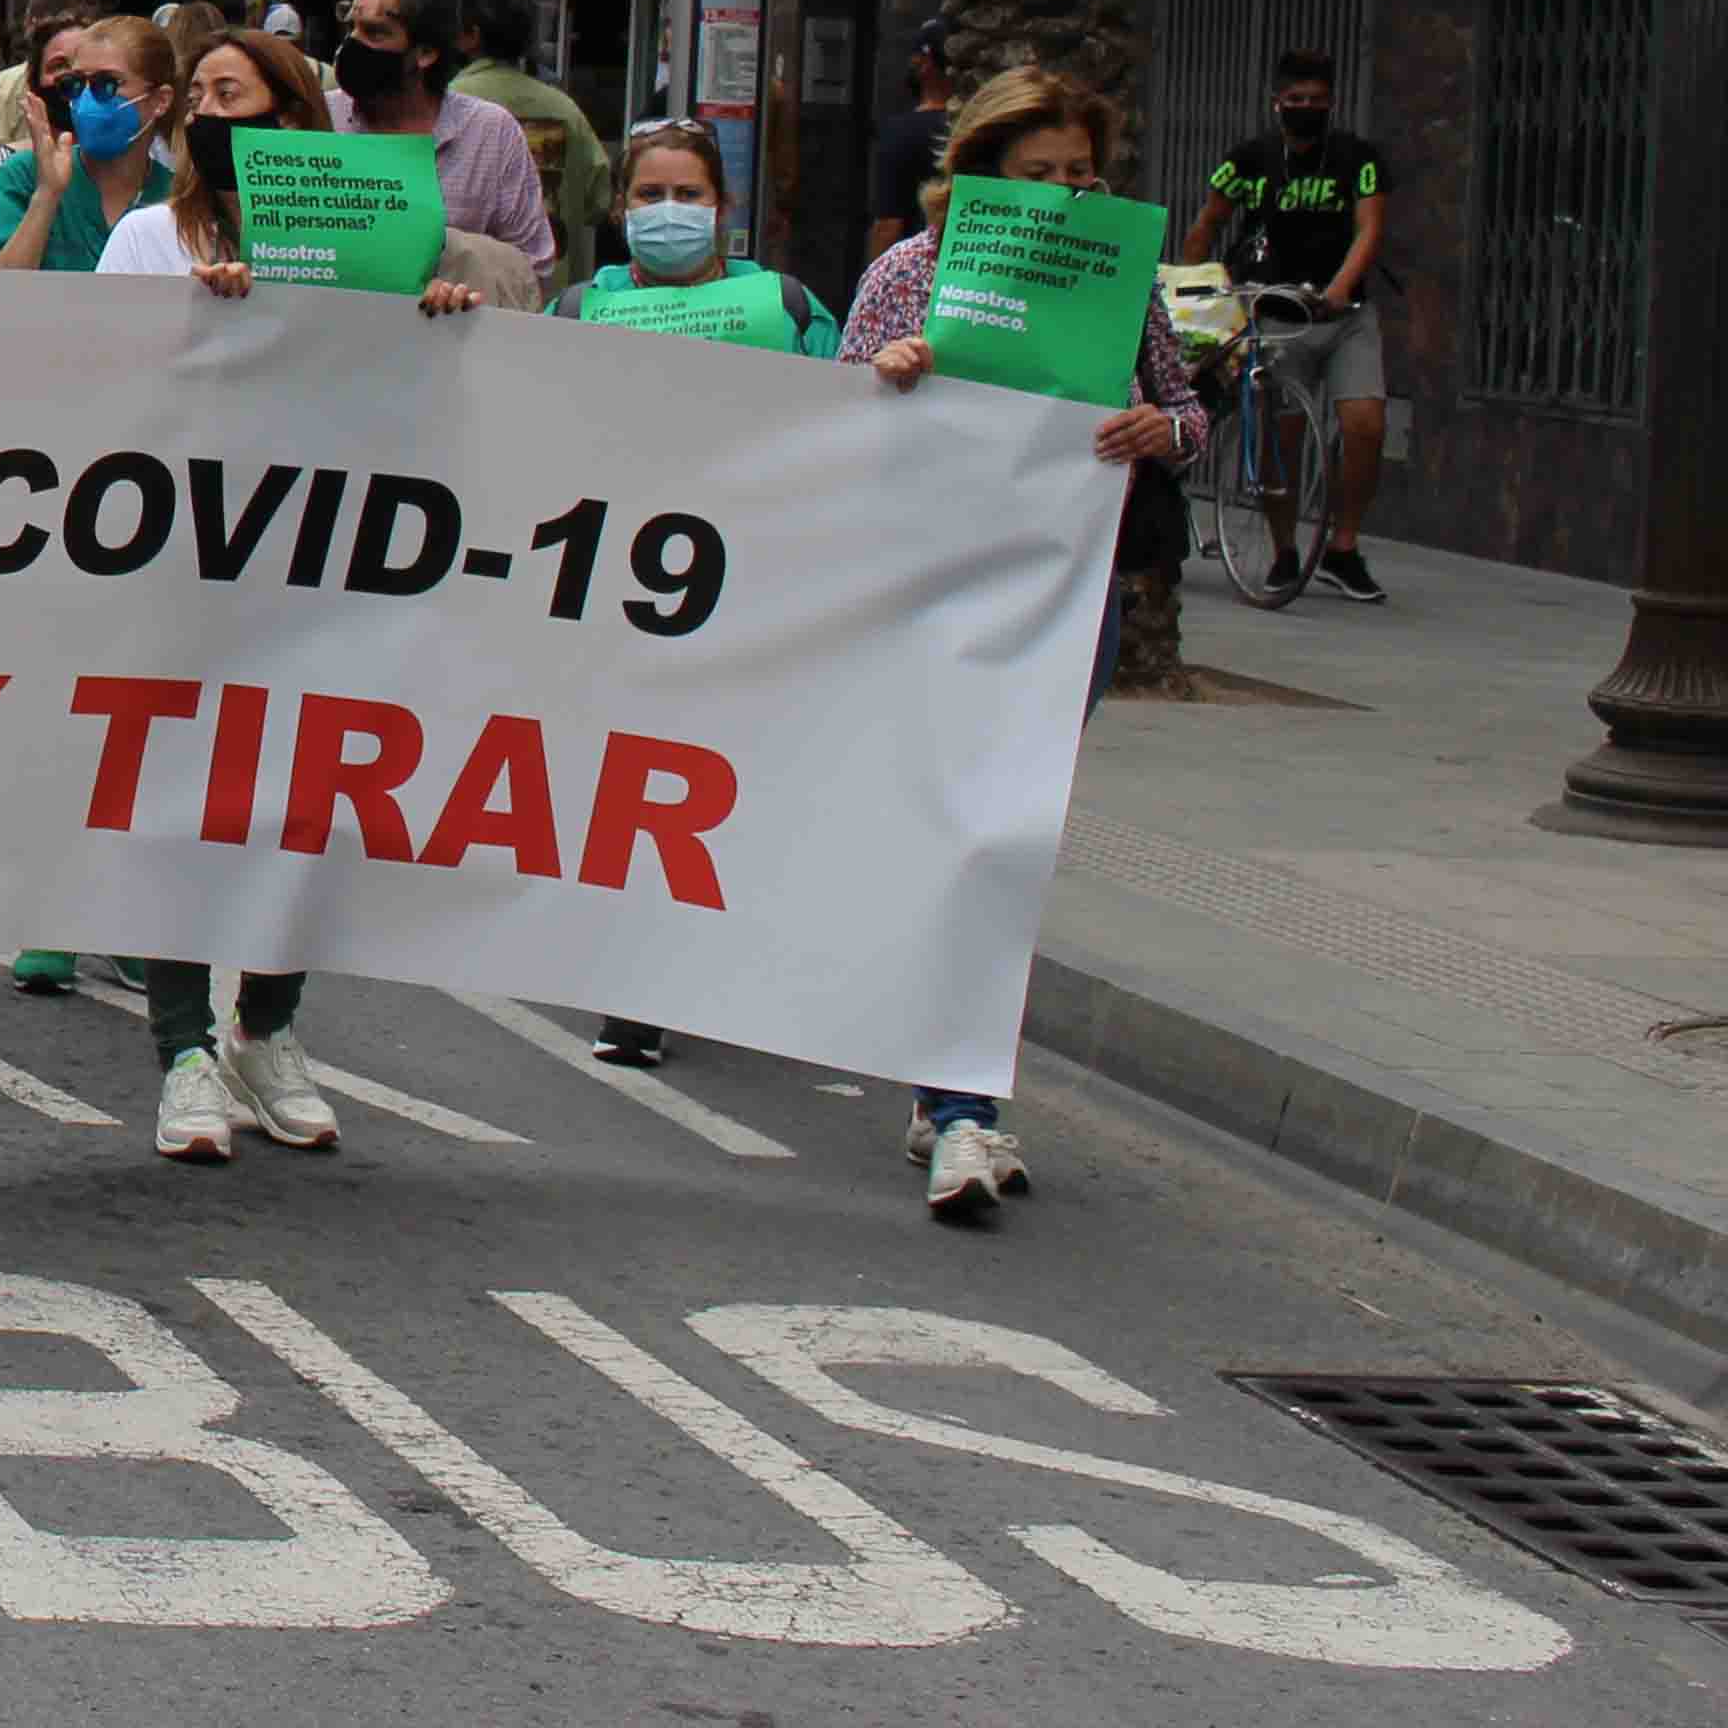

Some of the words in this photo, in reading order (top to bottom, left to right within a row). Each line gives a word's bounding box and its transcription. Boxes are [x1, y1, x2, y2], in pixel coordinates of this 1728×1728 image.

[245, 150, 305, 170] ¿Crees
[308, 155, 343, 172] que
[246, 171, 297, 187] cinco
[299, 172, 405, 192] enfermeras
[250, 191, 321, 209] pueden
[323, 194, 380, 211] cuidar
[384, 194, 409, 212] de
[959, 199, 1023, 219] ¿Crees
[1026, 206, 1067, 225] que
[252, 210, 282, 228] mil
[284, 213, 377, 232] personas?
[955, 218, 1007, 236] cinco
[1009, 223, 1121, 258] enfermeras
[251, 241, 337, 262] Nosotros
[950, 238, 1025, 258] pueden
[1028, 248, 1089, 271] cuidar
[1092, 258, 1118, 279] de
[251, 262, 339, 282] tampoco.
[945, 255, 976, 272] mil
[977, 260, 1079, 290] personas?
[652, 301, 688, 315] que
[938, 284, 1028, 314] Nosotros
[723, 317, 748, 333] de
[935, 302, 1027, 333] tampoco.
[70, 675, 739, 912] TIRAR
